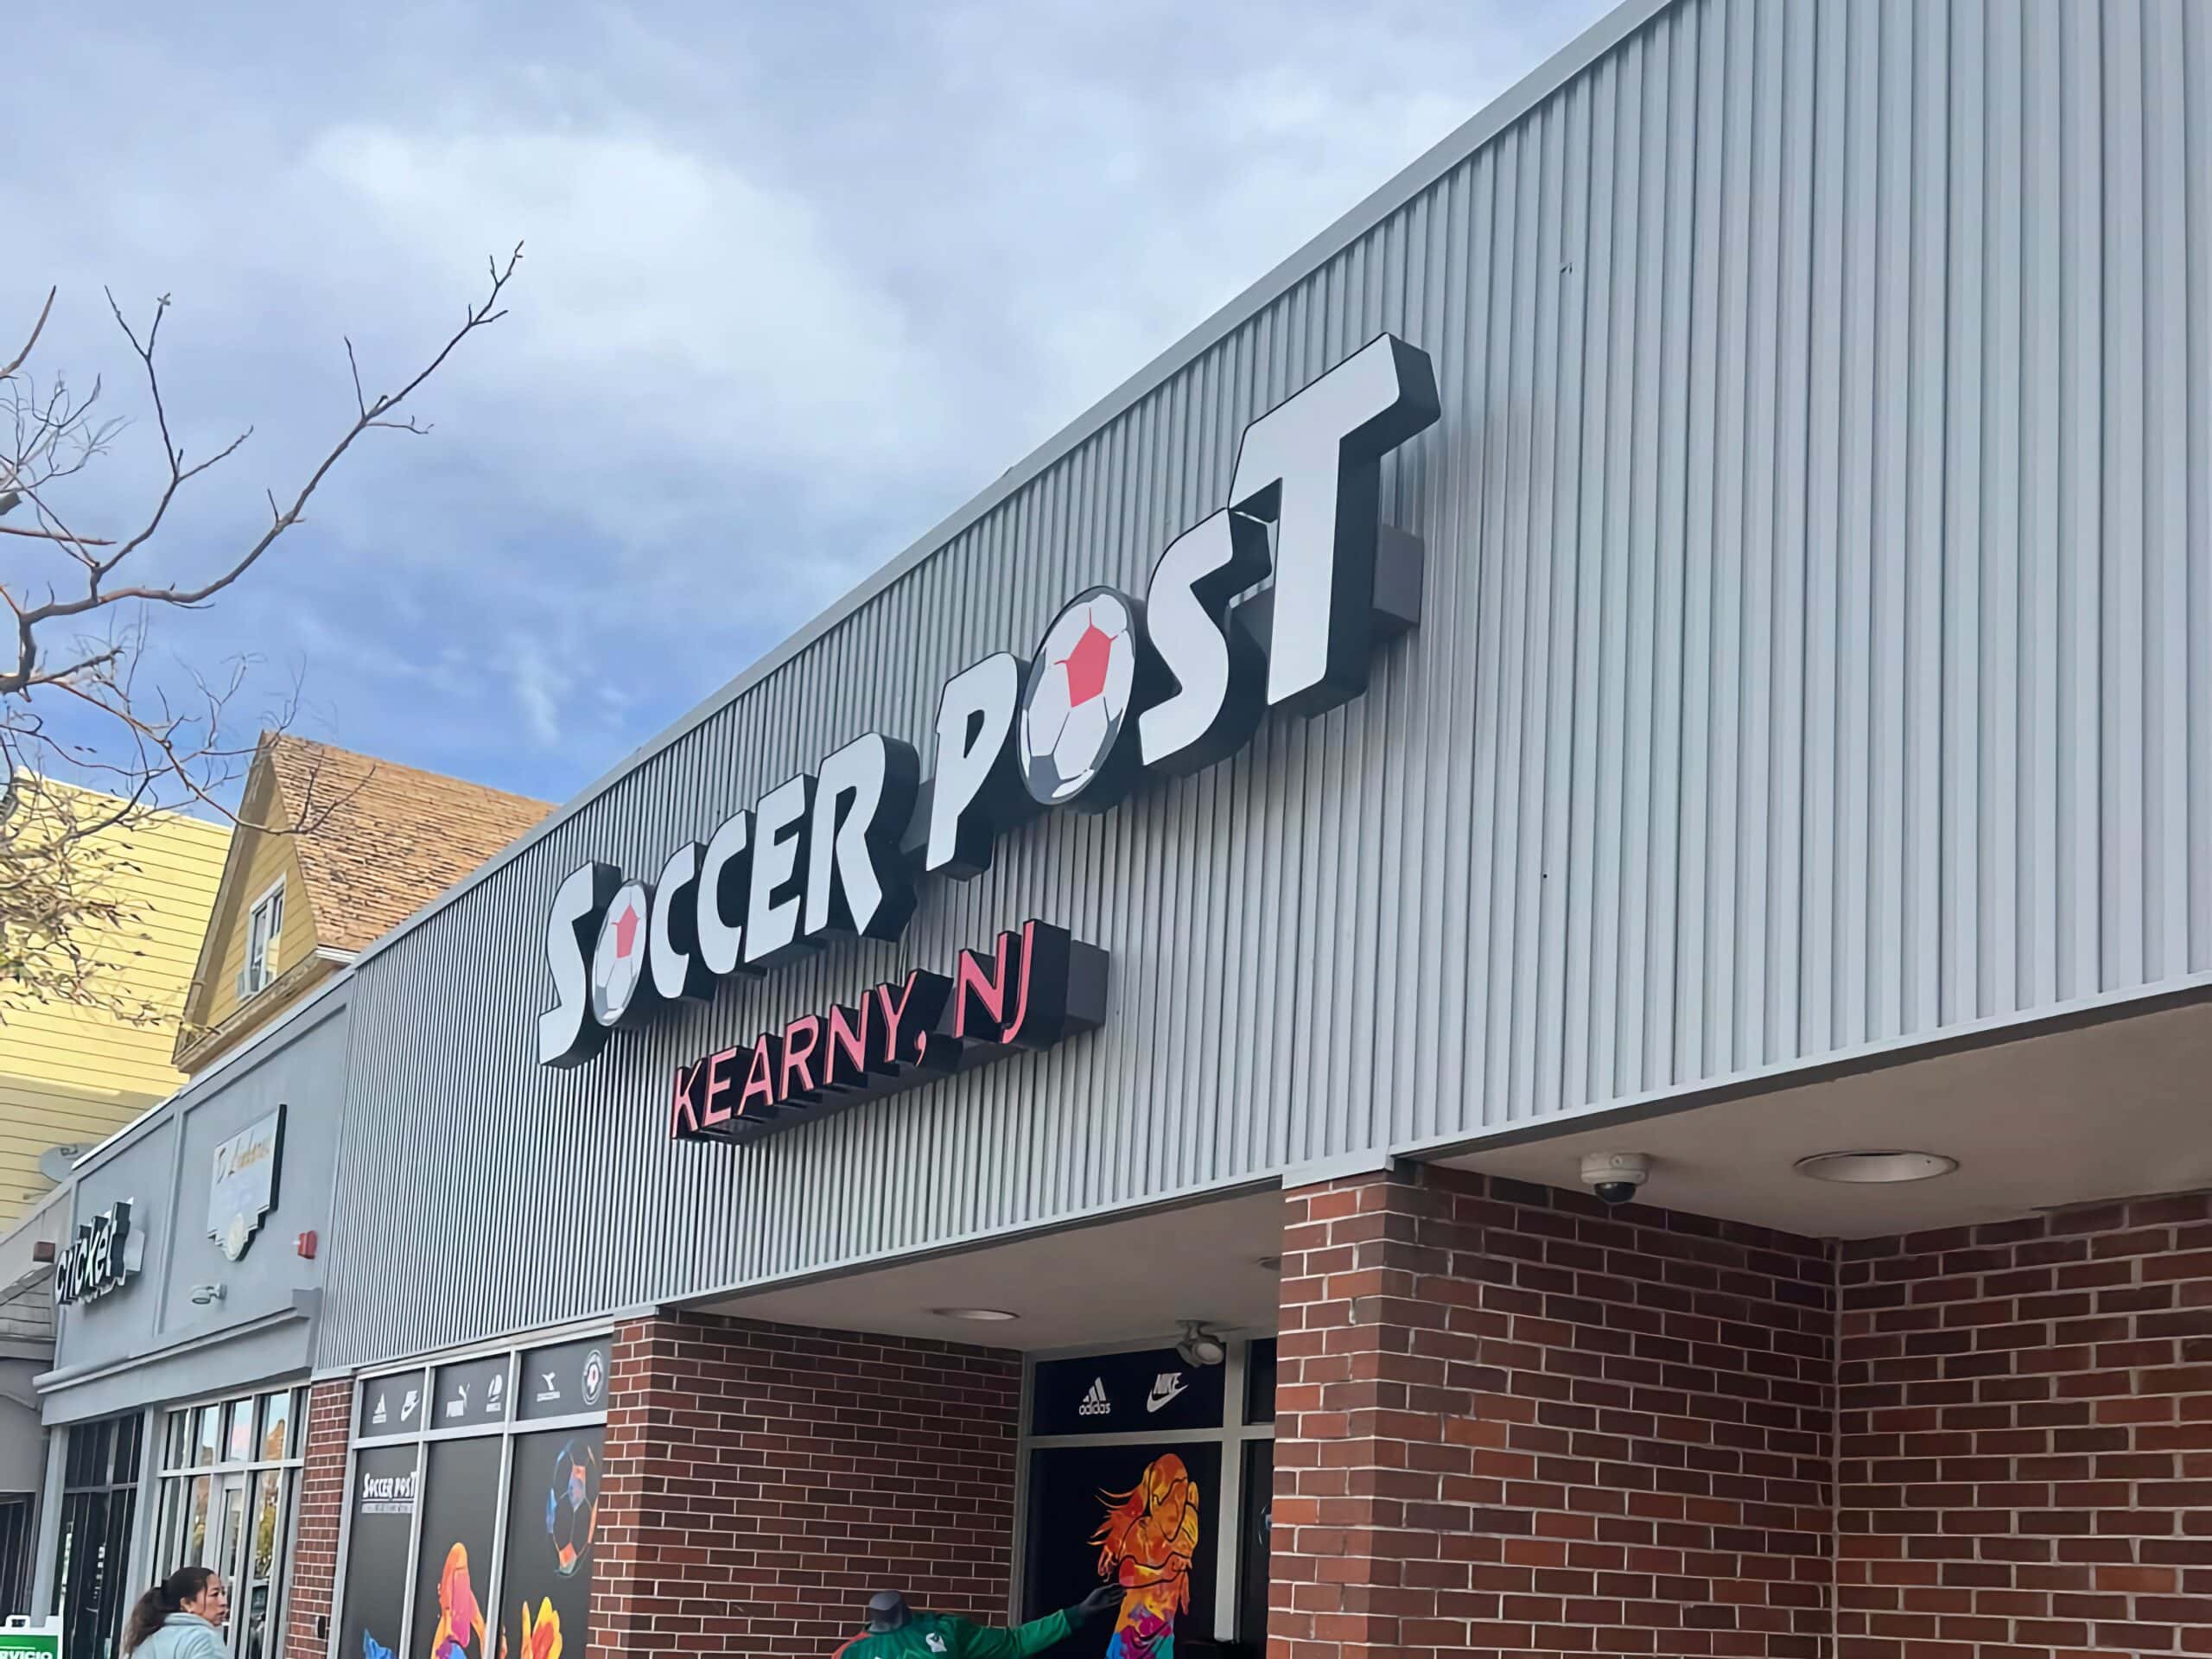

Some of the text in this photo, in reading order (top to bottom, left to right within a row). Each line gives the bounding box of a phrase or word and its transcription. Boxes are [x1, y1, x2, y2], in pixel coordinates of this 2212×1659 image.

[539, 332, 1402, 1065] SOCCER POST
[671, 918, 1035, 1138] KEARNY, NJ
[54, 1201, 122, 1305] cricket
[1078, 1400, 1111, 1415] adidas
